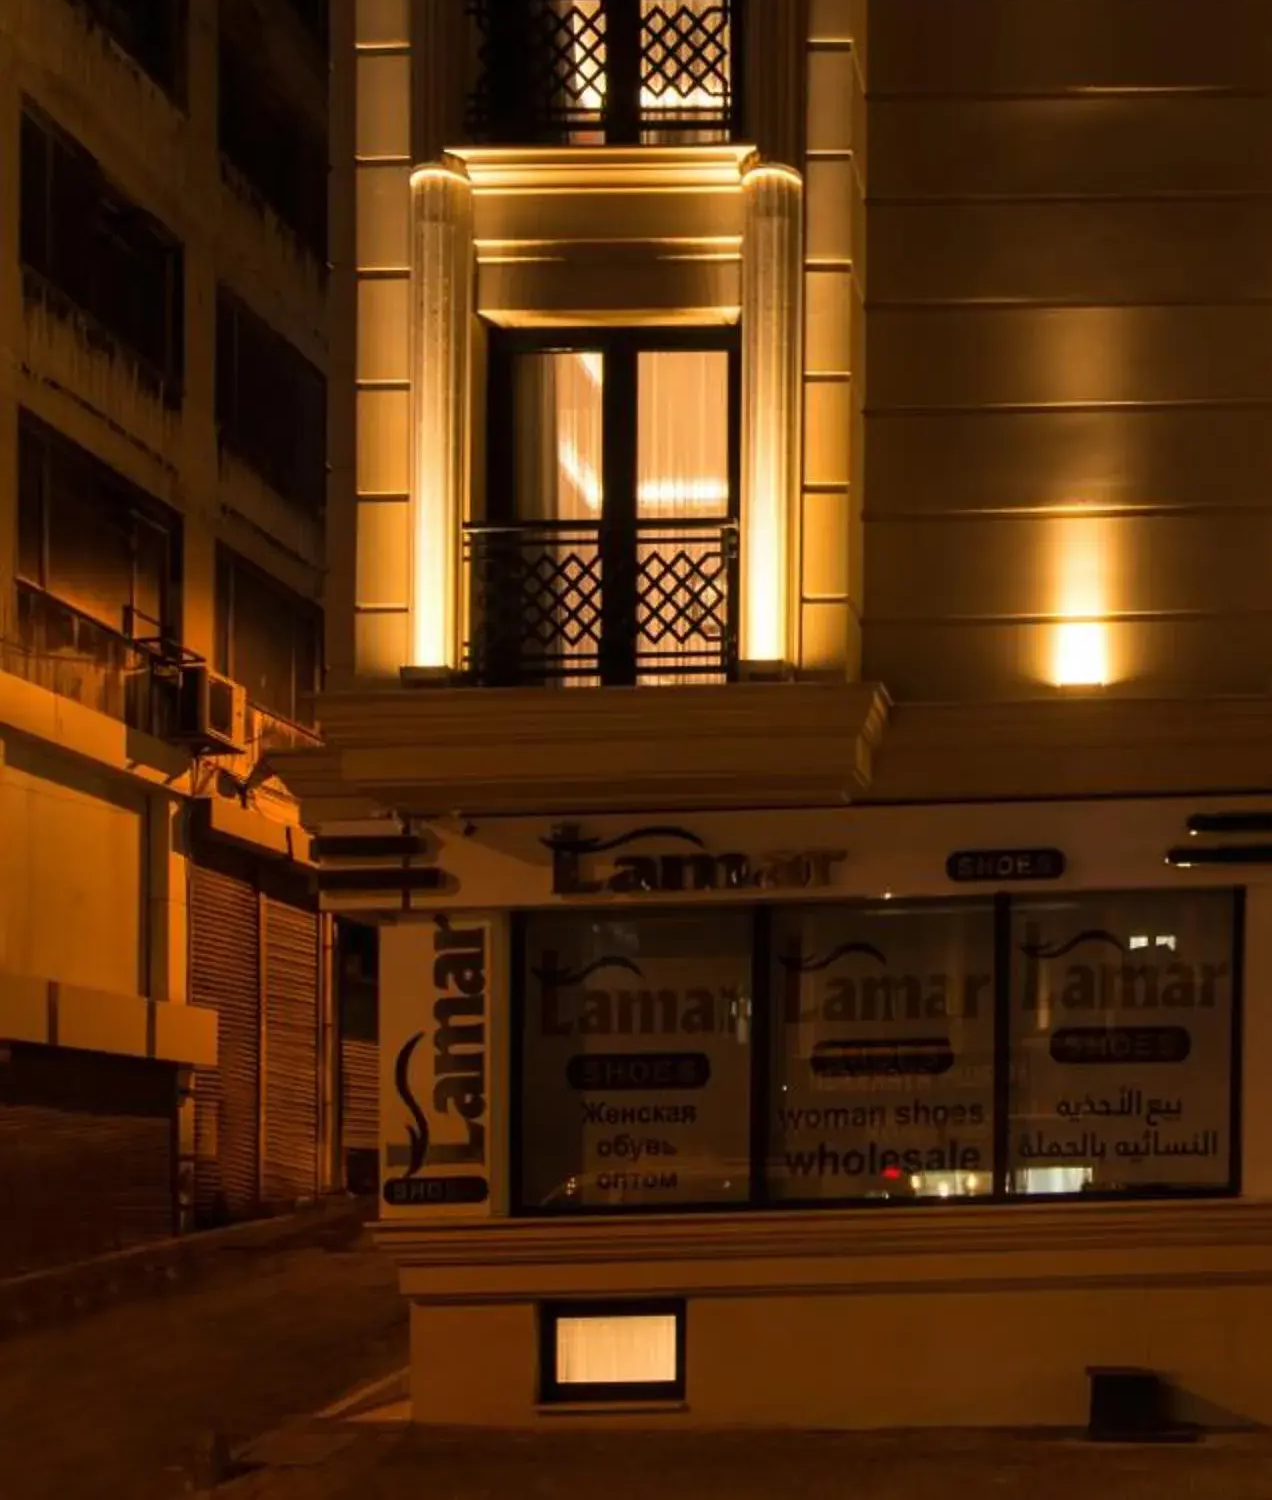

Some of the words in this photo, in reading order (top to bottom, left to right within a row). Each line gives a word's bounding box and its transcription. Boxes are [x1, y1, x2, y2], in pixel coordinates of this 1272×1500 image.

[784, 935, 991, 1023] Lamar
[1023, 921, 1228, 1011] Lamar
[386, 916, 486, 1165] Lamar
[580, 1100, 698, 1125] Женская
[777, 1106, 887, 1130] woman
[894, 1098, 984, 1126] shoes
[784, 1141, 981, 1177] wholesale
